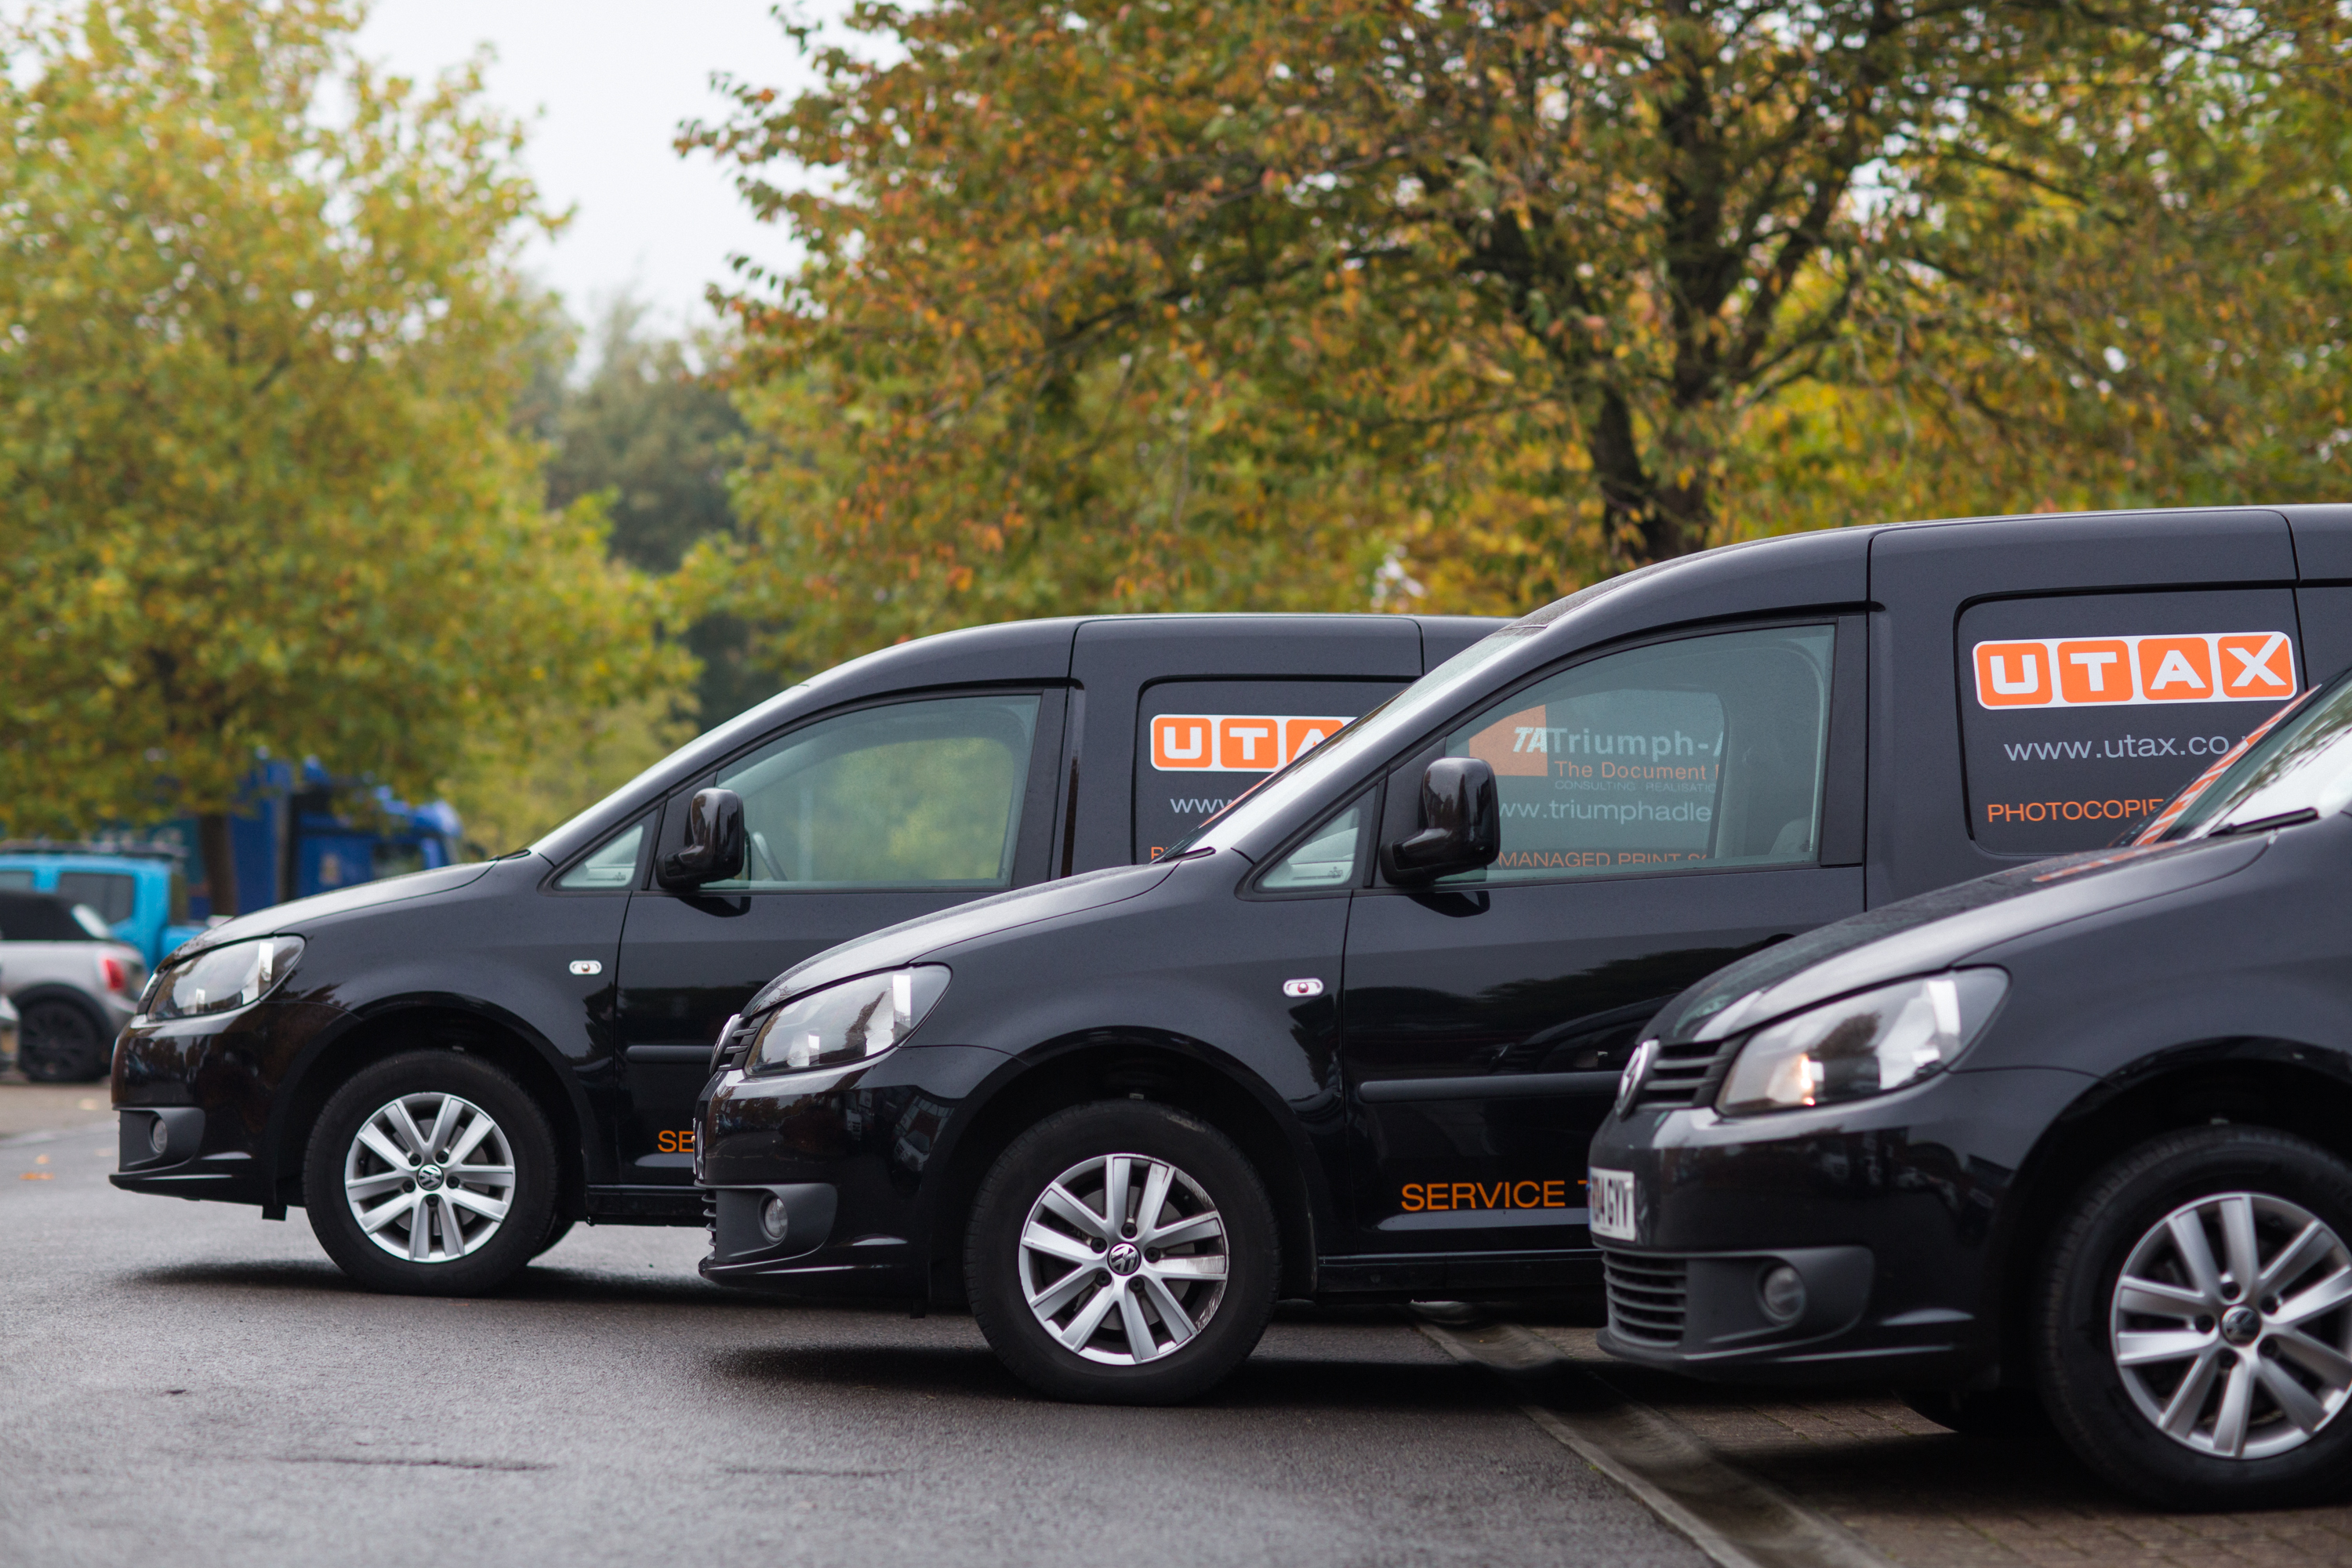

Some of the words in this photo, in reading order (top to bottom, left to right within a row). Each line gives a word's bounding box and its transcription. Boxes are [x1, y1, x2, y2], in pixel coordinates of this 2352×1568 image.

[1989, 633, 2288, 695] UTAX
[2003, 734, 2246, 761] www.utax.co
[1554, 760, 1593, 778] The
[1601, 761, 1707, 780] Document
[1498, 851, 1611, 868] MANAGED
[1401, 1180, 1566, 1211] SERVICE
